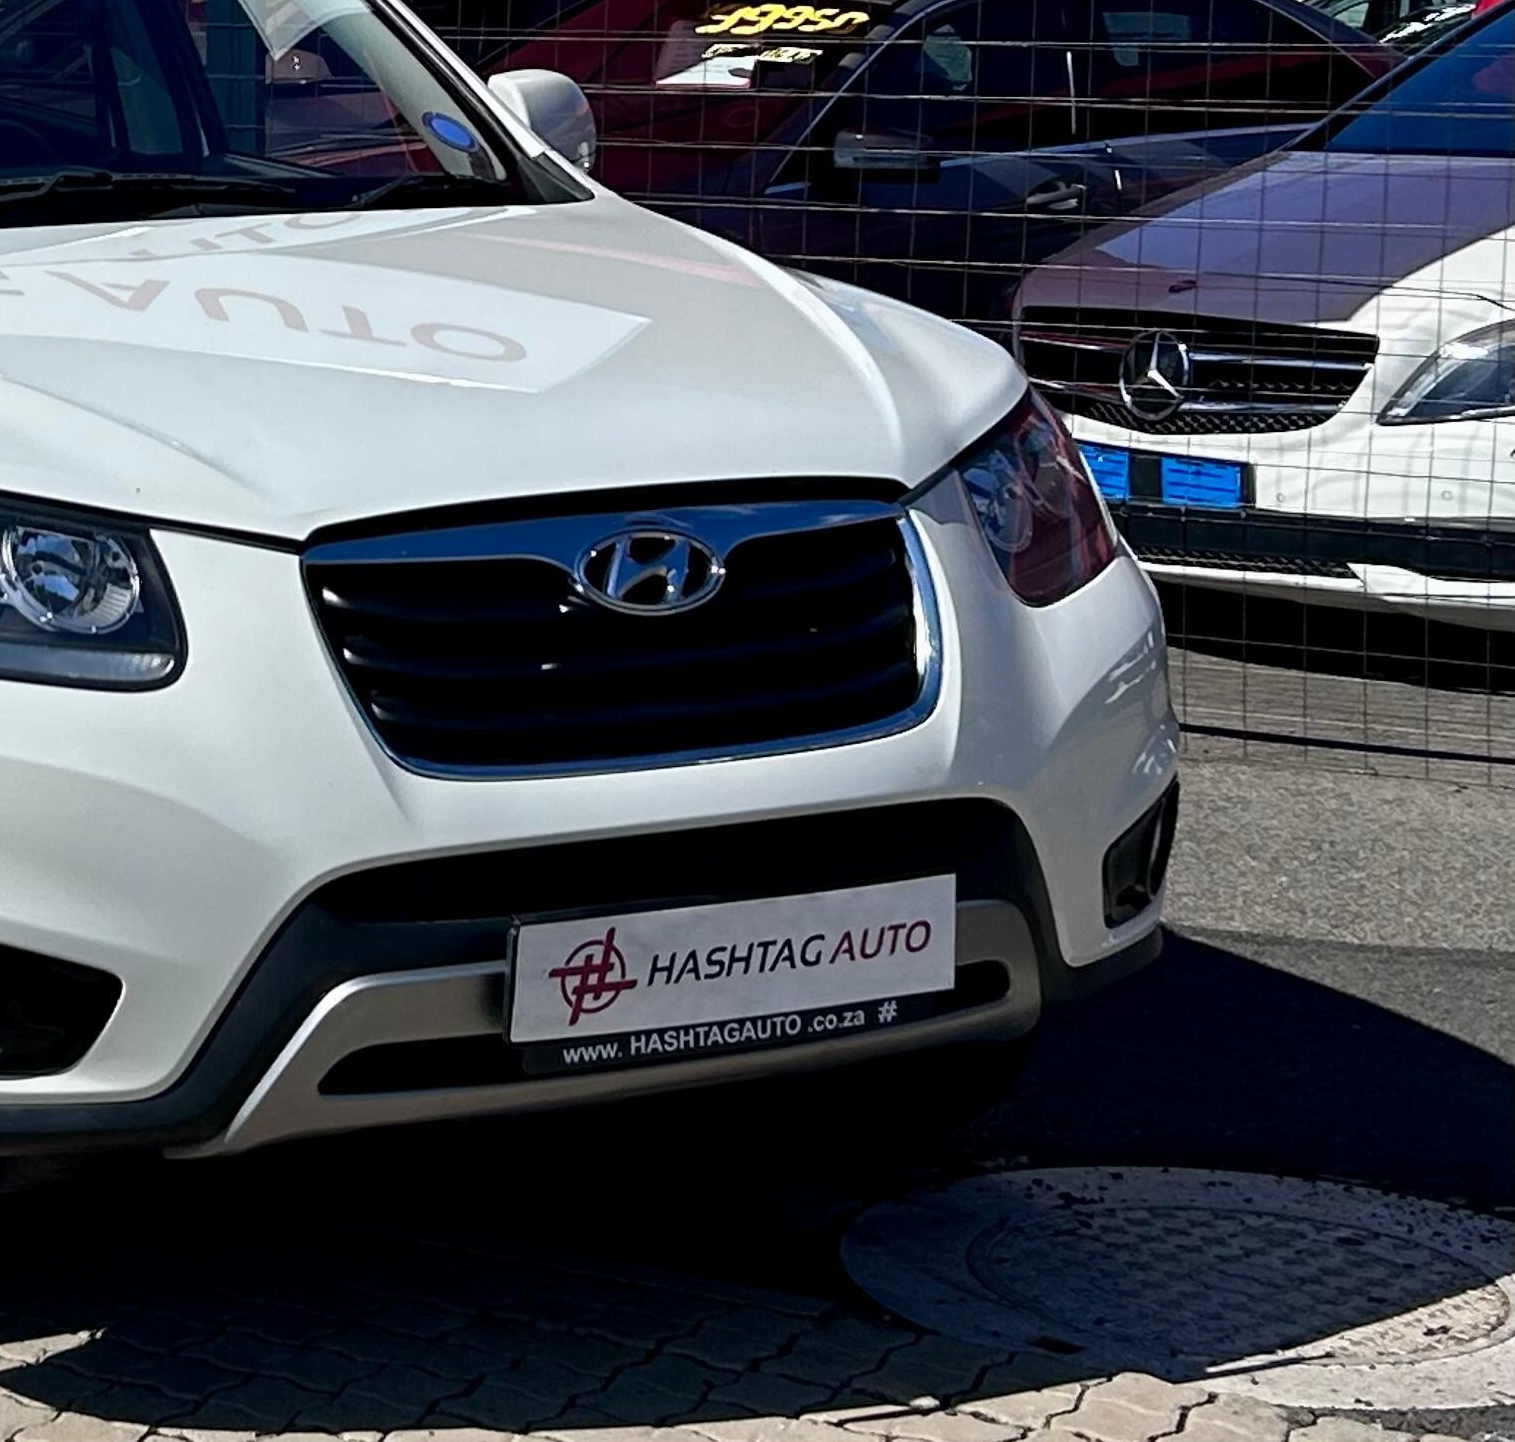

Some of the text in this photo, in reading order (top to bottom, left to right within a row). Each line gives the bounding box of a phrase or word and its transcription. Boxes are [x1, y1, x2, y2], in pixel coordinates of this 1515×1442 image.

[646, 919, 933, 987] HASHTAG AUTO
[562, 1042, 624, 1064] www.
[630, 1014, 802, 1056] HASHTAGAUTO
[807, 1008, 865, 1034] .co.za
